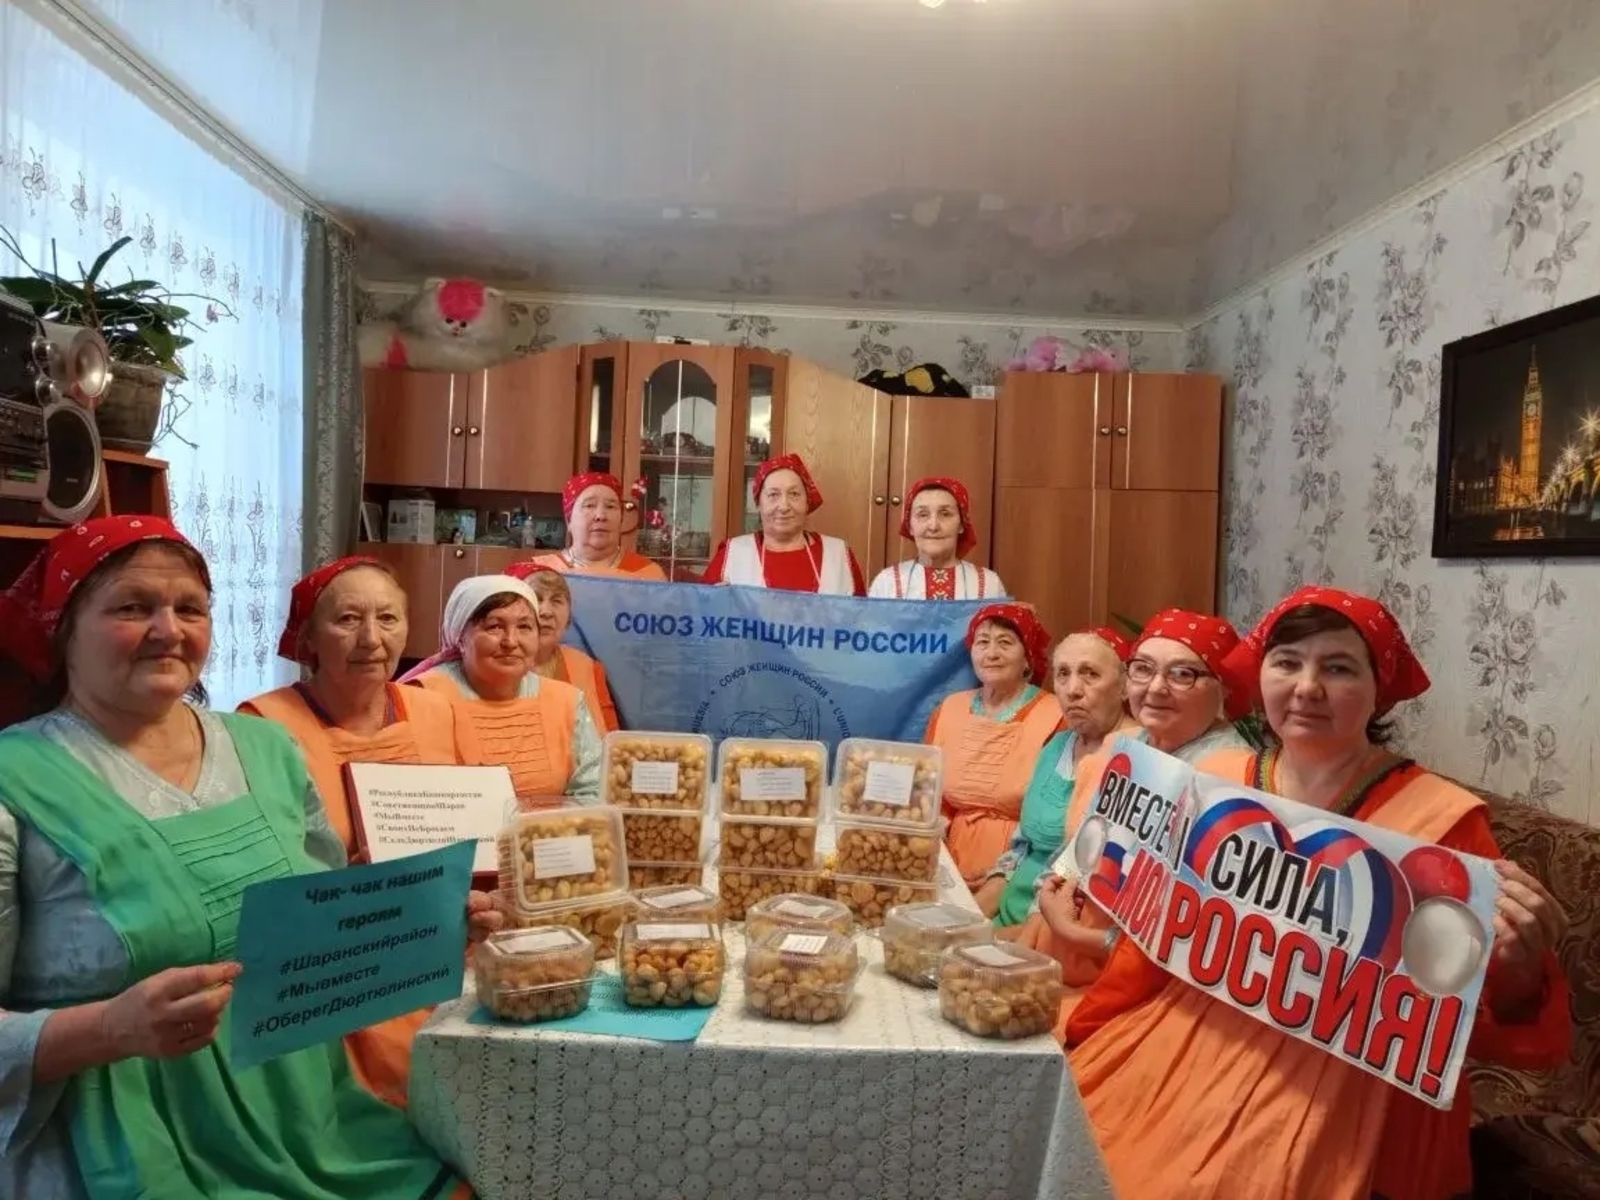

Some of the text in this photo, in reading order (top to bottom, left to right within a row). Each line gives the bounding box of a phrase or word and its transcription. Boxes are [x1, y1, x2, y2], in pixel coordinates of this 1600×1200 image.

[614, 611, 948, 655] СОЮЗ ЖЕНЩИН РОССИИ
[719, 661, 830, 699] СОЮЗ ЖЕНЩИН РОССИИ
[305, 865, 444, 905] Чак- чак нашим
[1210, 833, 1350, 949] СИЛА,
[337, 905, 403, 932] героям
[280, 924, 438, 976] #Шаранскийрайон
[252, 965, 450, 1038] #ОберегДюртюлинский
[277, 964, 381, 1002] #Мывместе
[1157, 880, 1464, 1100] РОССИЯ!
